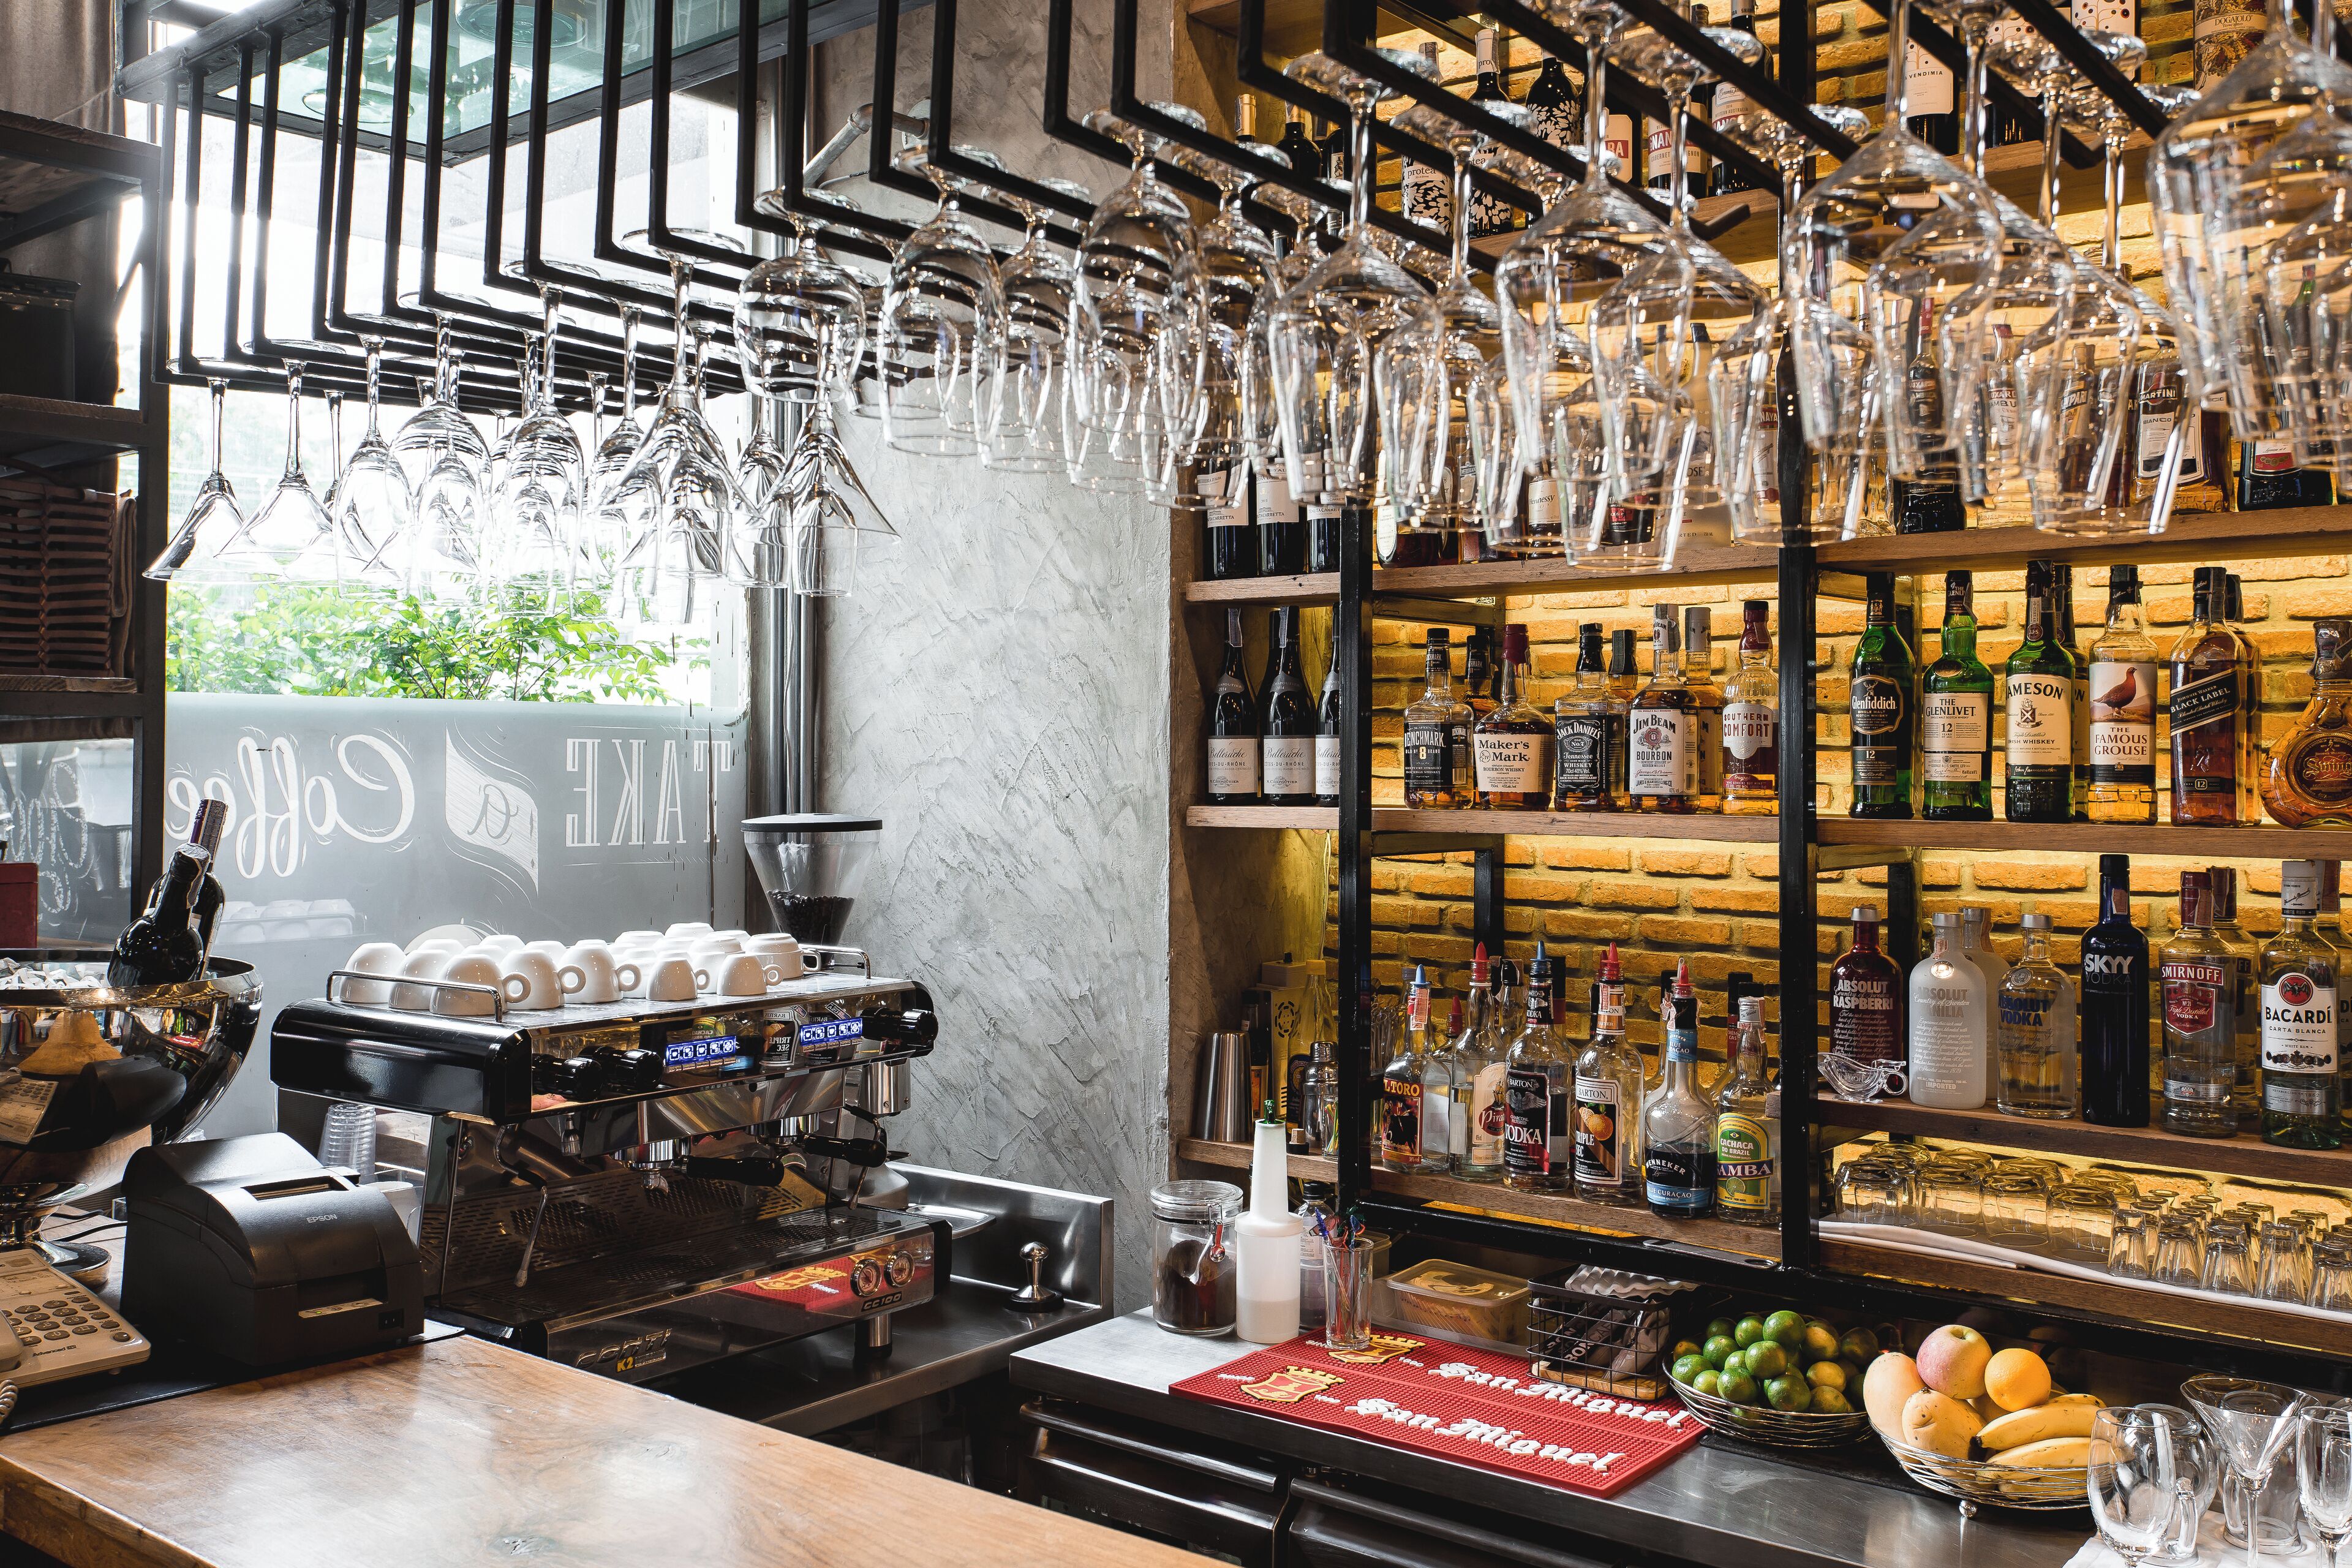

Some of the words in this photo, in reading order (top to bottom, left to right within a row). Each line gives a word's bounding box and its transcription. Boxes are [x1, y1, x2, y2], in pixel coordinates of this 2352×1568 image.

[1651, 153, 1671, 162] CABERNET
[1407, 167, 1436, 178] protea
[2140, 390, 2176, 400] MARTINI
[2006, 682, 2064, 701] AMESON
[2177, 691, 2197, 703] JOHNNIE
[2197, 685, 2217, 696] WALKER
[1852, 696, 1896, 709] Glenfiddich
[2170, 698, 2199, 714] BLACK
[2201, 687, 2231, 702] LABEL
[2177, 709, 2196, 719] Blended
[2196, 703, 2211, 712] Scotch
[2210, 698, 2228, 708] Whisky
[1634, 718, 1649, 734] JIM
[1650, 714, 1676, 734] BEAM
[1724, 713, 1769, 722] SOUTHERN
[1556, 725, 1574, 740] JACK
[1574, 722, 1602, 739] DANIEL'S
[1724, 723, 1770, 737] COMFORT
[1940, 723, 1953, 733] 12
[1479, 739, 1530, 750] Maker's
[2095, 734, 2147, 744] FAMOUS
[1419, 747, 1427, 760] 8
[1491, 752, 1529, 761] Mark
[1637, 751, 1672, 761] BOURBON
[1866, 750, 1875, 759] 12
[2095, 745, 2147, 755] GROUSE
[2084, 953, 2134, 974] SKYY
[2085, 972, 2132, 985] VODKA
[2162, 966, 2220, 981] SMIRNOFF
[1834, 986, 1856, 998] Country
[1838, 979, 1888, 993] ABSOLUT
[1833, 995, 1893, 1009] RASPBERRI
[1913, 992, 1937, 1008] Country
[1937, 999, 1945, 1008] of
[2182, 1006, 2210, 1015] Distilled
[2266, 1005, 2332, 1024] BACARDÍ
[2000, 1009, 2043, 1027] VODKA
[1390, 1082, 1420, 1096] TORO
[1576, 1131, 1594, 1146] TRIPLE
[1575, 1145, 1584, 1158] SEC
[1717, 1164, 1771, 1176] AMBA
[1657, 1189, 1692, 1199] CURAÇAO
[306, 1213, 338, 1223] EPSON
[32, 1347, 67, 1357] Advanced
[617, 1356, 634, 1373] K2
[1428, 1362, 1520, 1391] San
[1515, 1380, 1691, 1428] Miguel
[1344, 1398, 1441, 1430] San
[1434, 1418, 1626, 1472] Miguel
